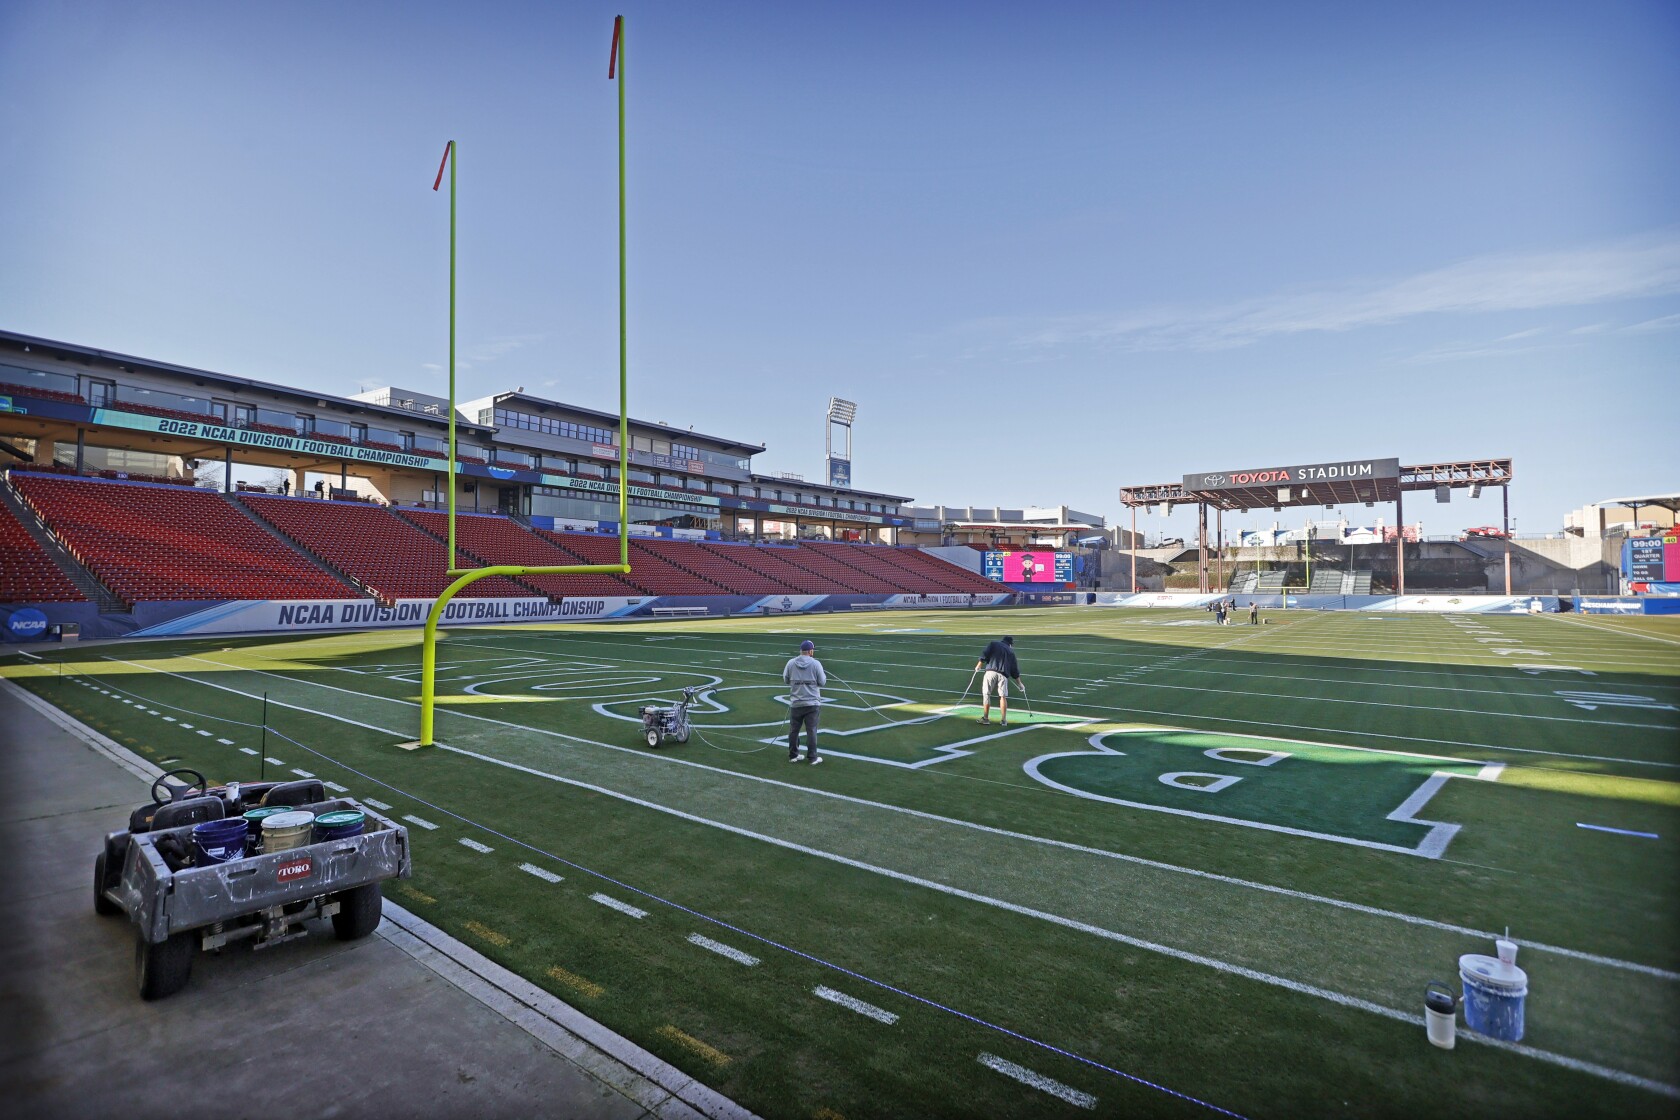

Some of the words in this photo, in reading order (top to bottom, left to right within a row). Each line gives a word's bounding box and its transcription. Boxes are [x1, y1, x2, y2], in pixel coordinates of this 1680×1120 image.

[158, 419, 198, 436] 2022
[201, 425, 236, 441] NCAA
[239, 430, 293, 449] DIVISION
[295, 439, 300, 450] I
[302, 440, 354, 458] FOOTBALL
[357, 448, 430, 467] CHAMPIONSHIP
[1229, 470, 1291, 484] TOYOTA
[1298, 463, 1372, 480] STADIUM
[569, 478, 588, 488] 2022
[588, 481, 605, 491] NCAA
[636, 487, 663, 498] FOOTBALL
[664, 491, 703, 502] CHAMPIONSHIP
[1632, 540, 1661, 548] 99:00
[278, 604, 334, 625] NCAA
[441, 602, 509, 619] OOTBALL
[513, 600, 605, 617] CHAMPIONSHIP
[11, 620, 46, 630] NCAA
[278, 863, 310, 877] TORO
